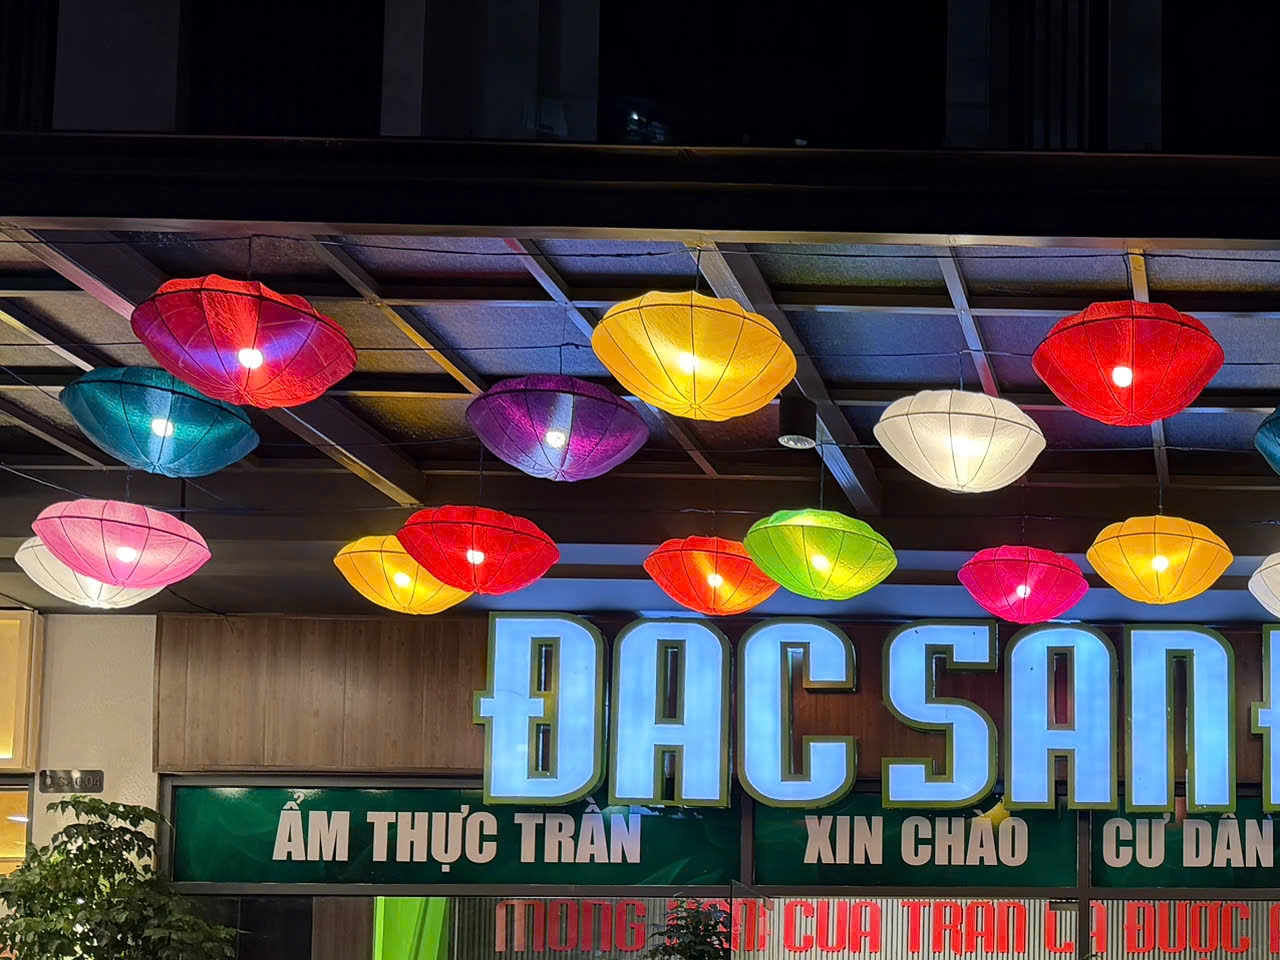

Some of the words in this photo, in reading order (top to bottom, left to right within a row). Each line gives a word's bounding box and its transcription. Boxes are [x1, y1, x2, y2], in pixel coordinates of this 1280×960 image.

[272, 791, 349, 861] ẨM
[366, 804, 498, 872] THỰC
[514, 796, 641, 863] TRẦN
[803, 815, 883, 865] XIN
[900, 808, 1029, 867] CHÀO
[1102, 813, 1171, 868] CƯ
[1182, 813, 1274, 868] DÂN
